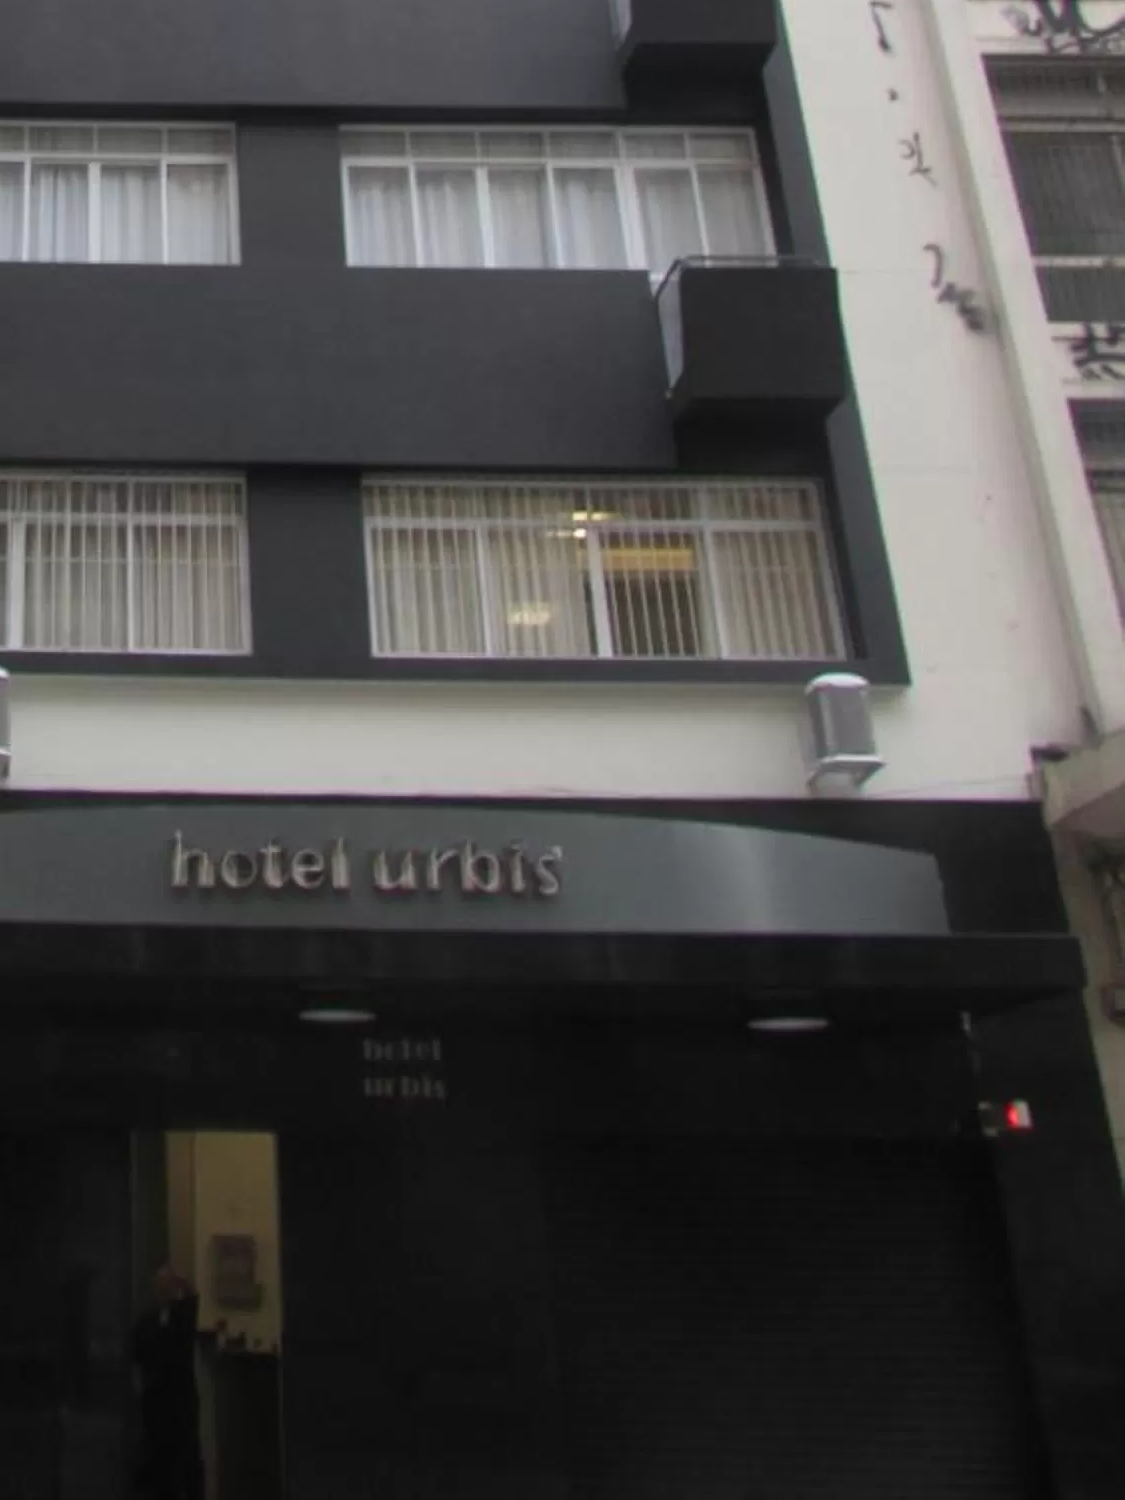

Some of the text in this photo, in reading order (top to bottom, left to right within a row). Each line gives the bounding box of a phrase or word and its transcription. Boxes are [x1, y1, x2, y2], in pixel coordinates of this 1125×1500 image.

[171, 829, 564, 895] hotel urbis
[362, 1037, 442, 1061] hotel
[362, 1074, 448, 1101] urbis
